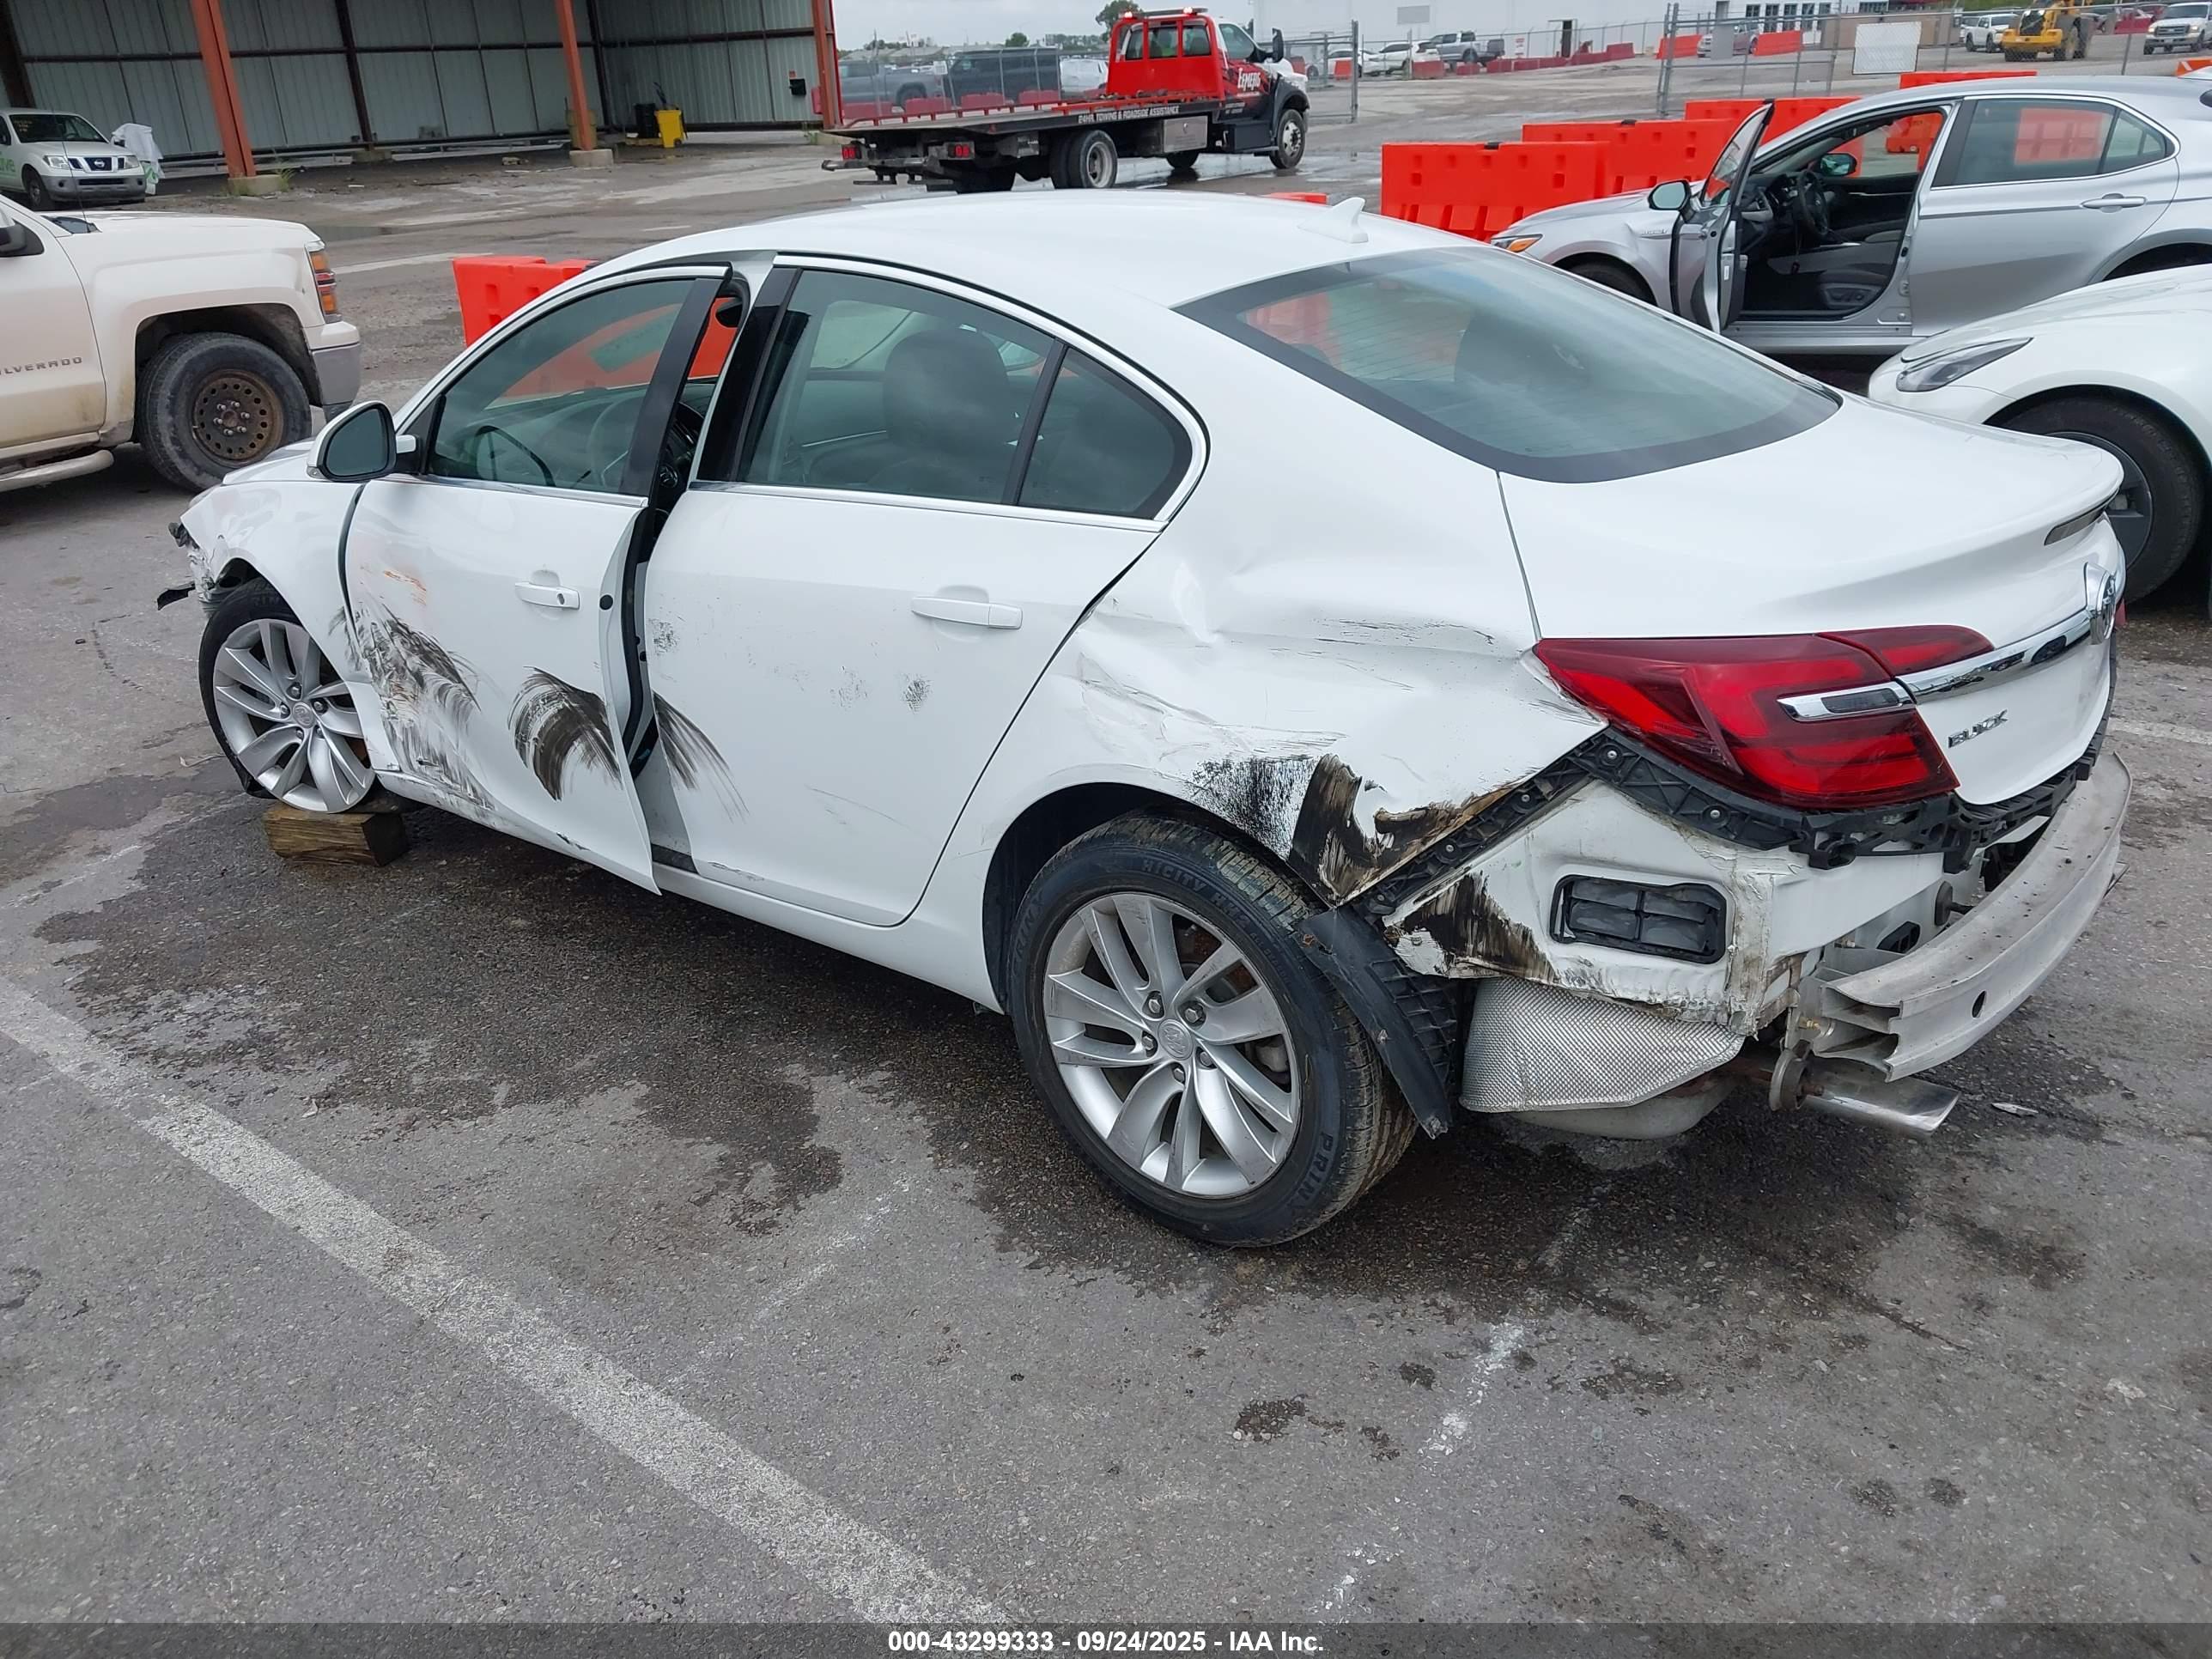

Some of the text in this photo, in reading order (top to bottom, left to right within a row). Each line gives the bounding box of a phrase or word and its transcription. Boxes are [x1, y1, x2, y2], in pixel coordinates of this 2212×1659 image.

[1096, 111, 1117, 121] TOWING
[1123, 108, 1149, 119] ROADSIDE
[1150, 105, 1180, 117] ASSISTANCE
[1948, 709, 2008, 749] BUICK
[1142, 860, 1206, 891] HICITY
